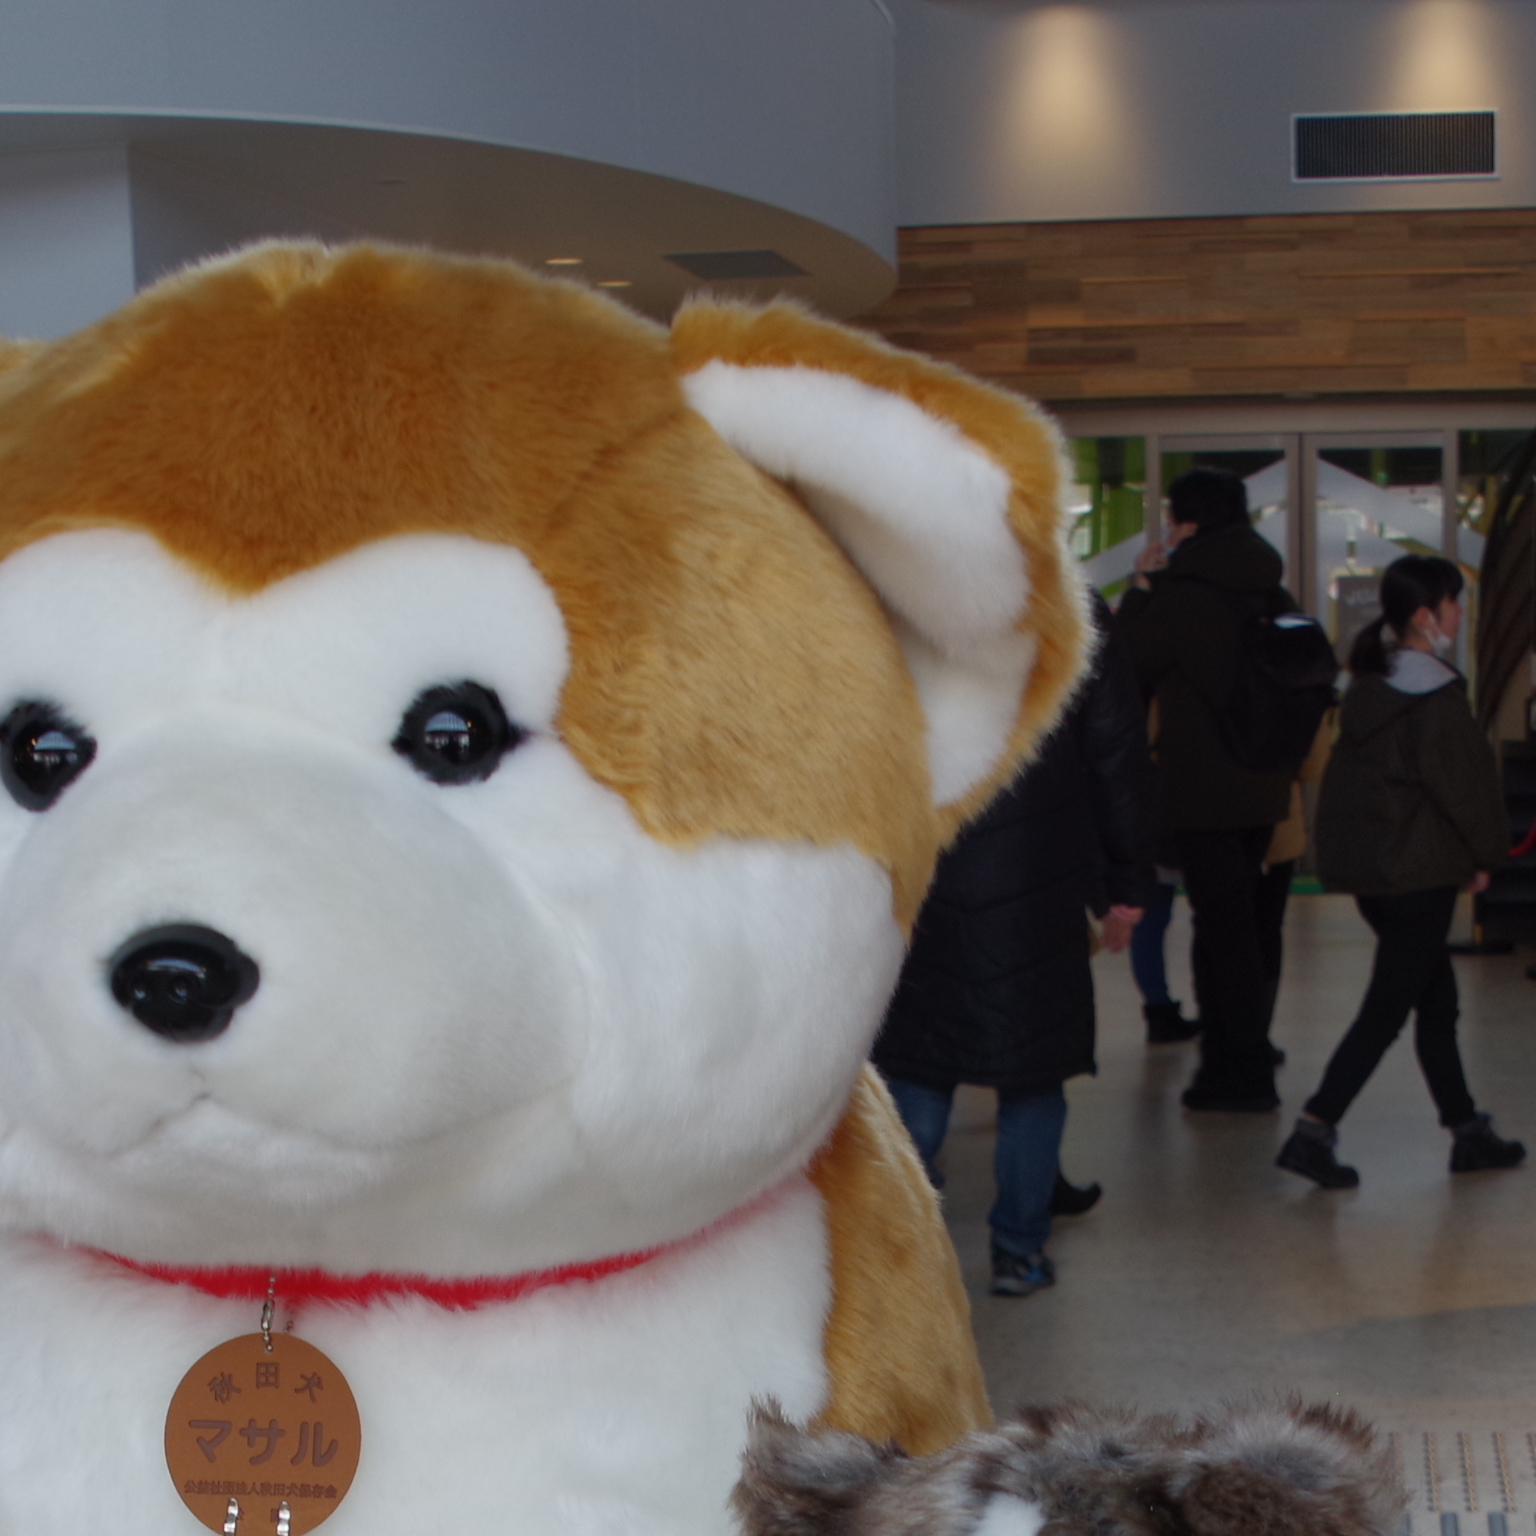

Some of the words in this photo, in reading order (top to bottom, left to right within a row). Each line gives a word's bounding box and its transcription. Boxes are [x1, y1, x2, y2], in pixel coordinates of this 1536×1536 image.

[207, 1361, 325, 1404] 秋田犬
[187, 1417, 339, 1469] マサル
